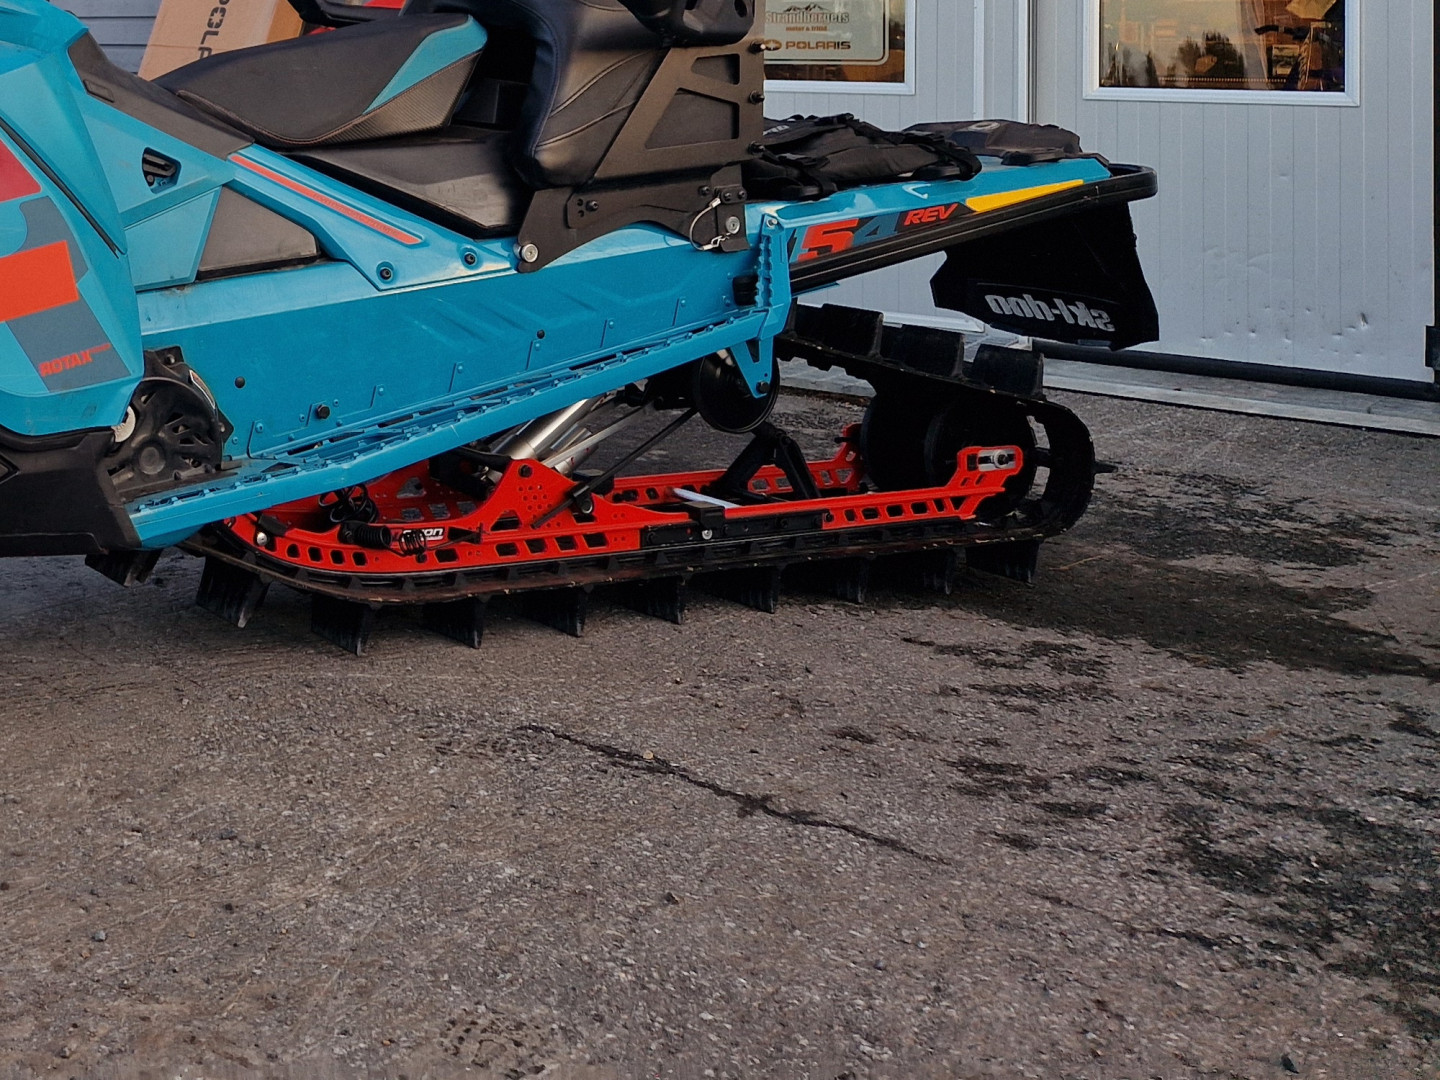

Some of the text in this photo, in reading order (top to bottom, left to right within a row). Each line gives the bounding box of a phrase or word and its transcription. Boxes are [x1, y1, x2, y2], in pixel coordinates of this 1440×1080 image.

[785, 40, 852, 51] POLARIS
[903, 202, 959, 226] REV
[38, 351, 93, 378] ROTAX
